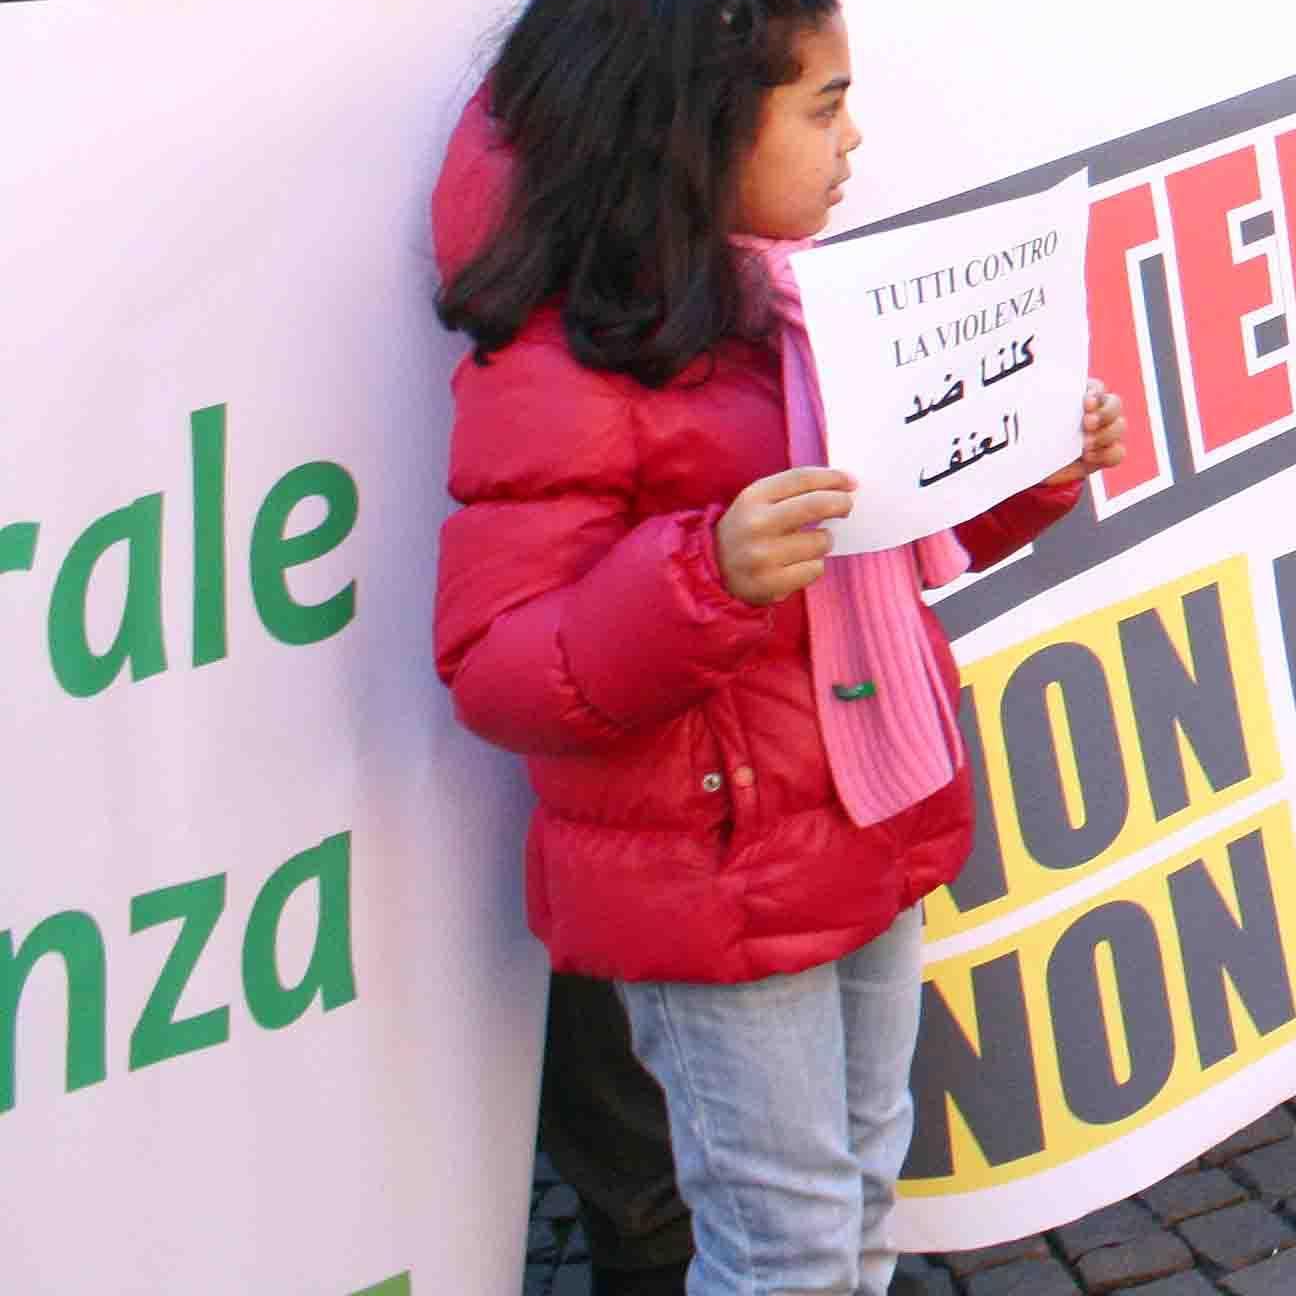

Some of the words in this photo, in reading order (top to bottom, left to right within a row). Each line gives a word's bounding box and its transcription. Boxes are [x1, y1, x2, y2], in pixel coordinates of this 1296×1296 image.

[866, 266, 957, 317] TUTTI
[964, 229, 1059, 289] CONTRO
[892, 334, 930, 368] LA
[935, 285, 1047, 352] VIOLENZA
[980, 333, 1036, 388] كلنا
[903, 373, 965, 425] ضد
[918, 410, 1021, 489] العنف
[897, 827, 1296, 1180] NON
